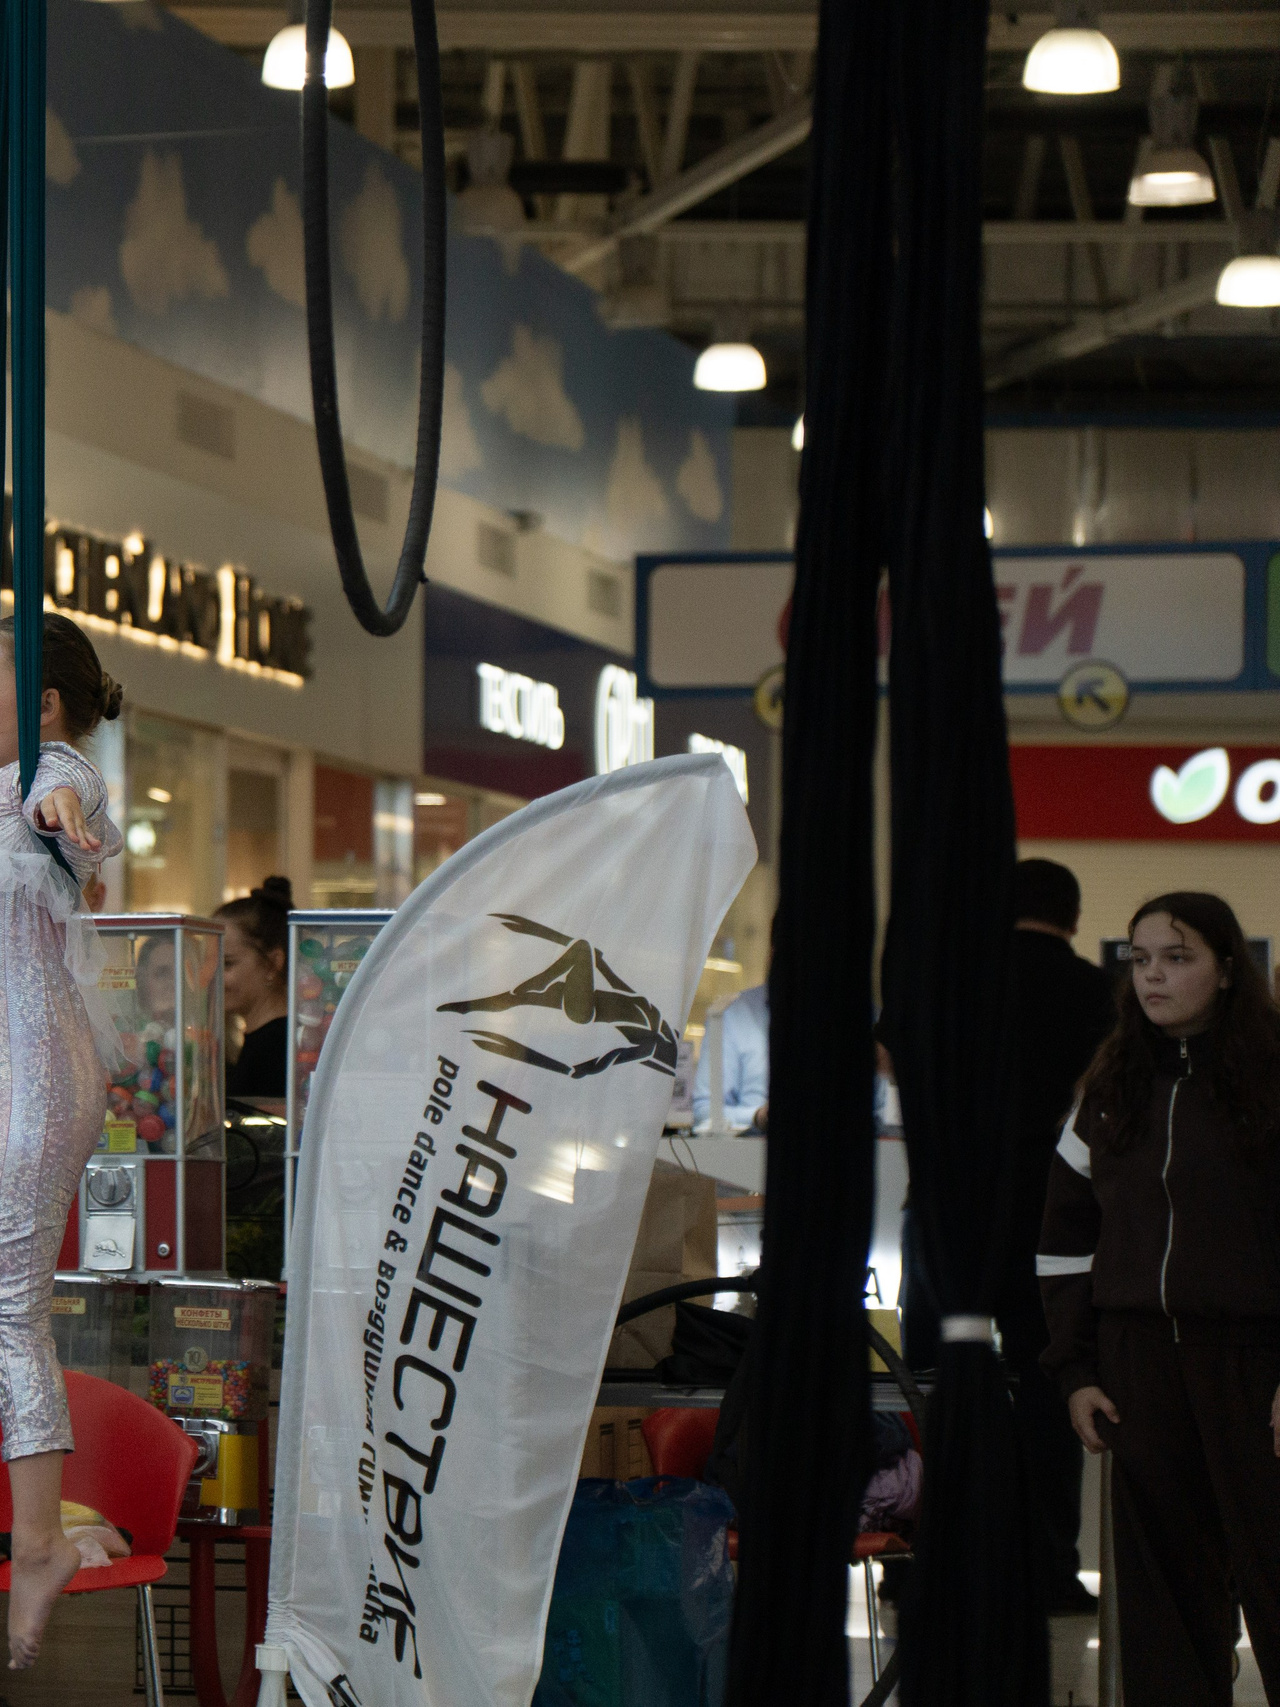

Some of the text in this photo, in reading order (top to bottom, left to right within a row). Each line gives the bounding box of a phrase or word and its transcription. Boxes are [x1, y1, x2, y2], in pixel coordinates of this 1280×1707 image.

[423, 1055, 460, 1125] pole
[392, 1131, 437, 1224] dance
[384, 1229, 408, 1254] &
[180, 1309, 222, 1318] КОНФЕТЫ
[213, 1321, 230, 1329] ШТУК
[187, 1350, 201, 1365] 10
